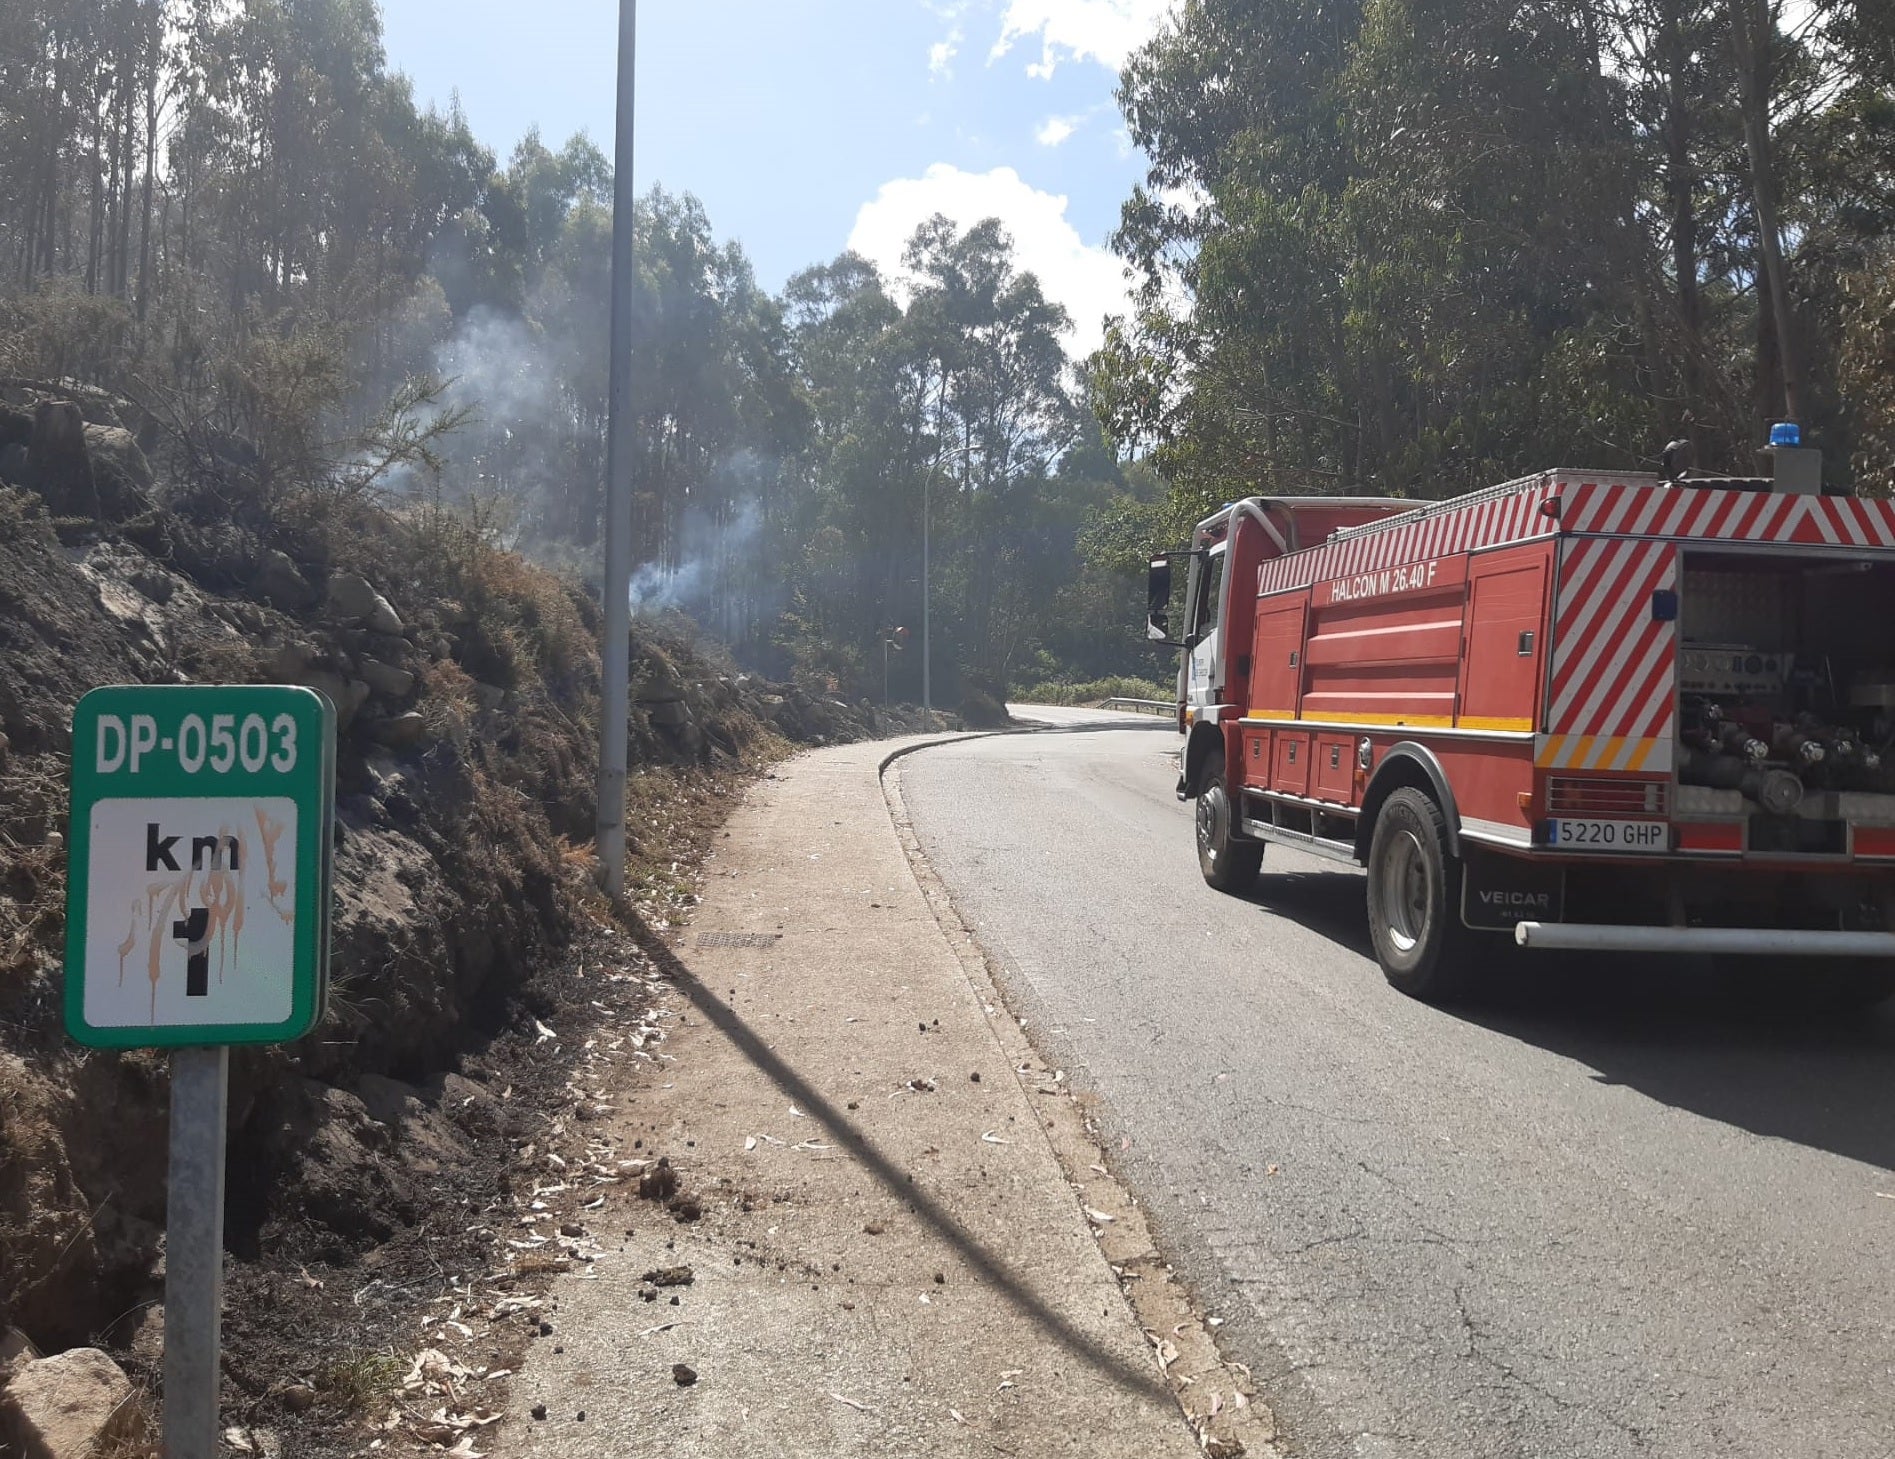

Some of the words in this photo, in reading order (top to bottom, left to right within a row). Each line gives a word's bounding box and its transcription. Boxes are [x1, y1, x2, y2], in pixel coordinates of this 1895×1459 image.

[1331, 573, 1377, 602] HALCON
[1379, 570, 1390, 595] M
[1392, 564, 1424, 592] 26.40
[1427, 561, 1437, 586] F
[95, 712, 298, 774] DP-0503
[145, 823, 240, 871] km
[1562, 822, 1615, 843] 5220
[1623, 825, 1662, 845] GHP
[1479, 891, 1550, 907] VEICAR
[173, 908, 210, 997] 1
